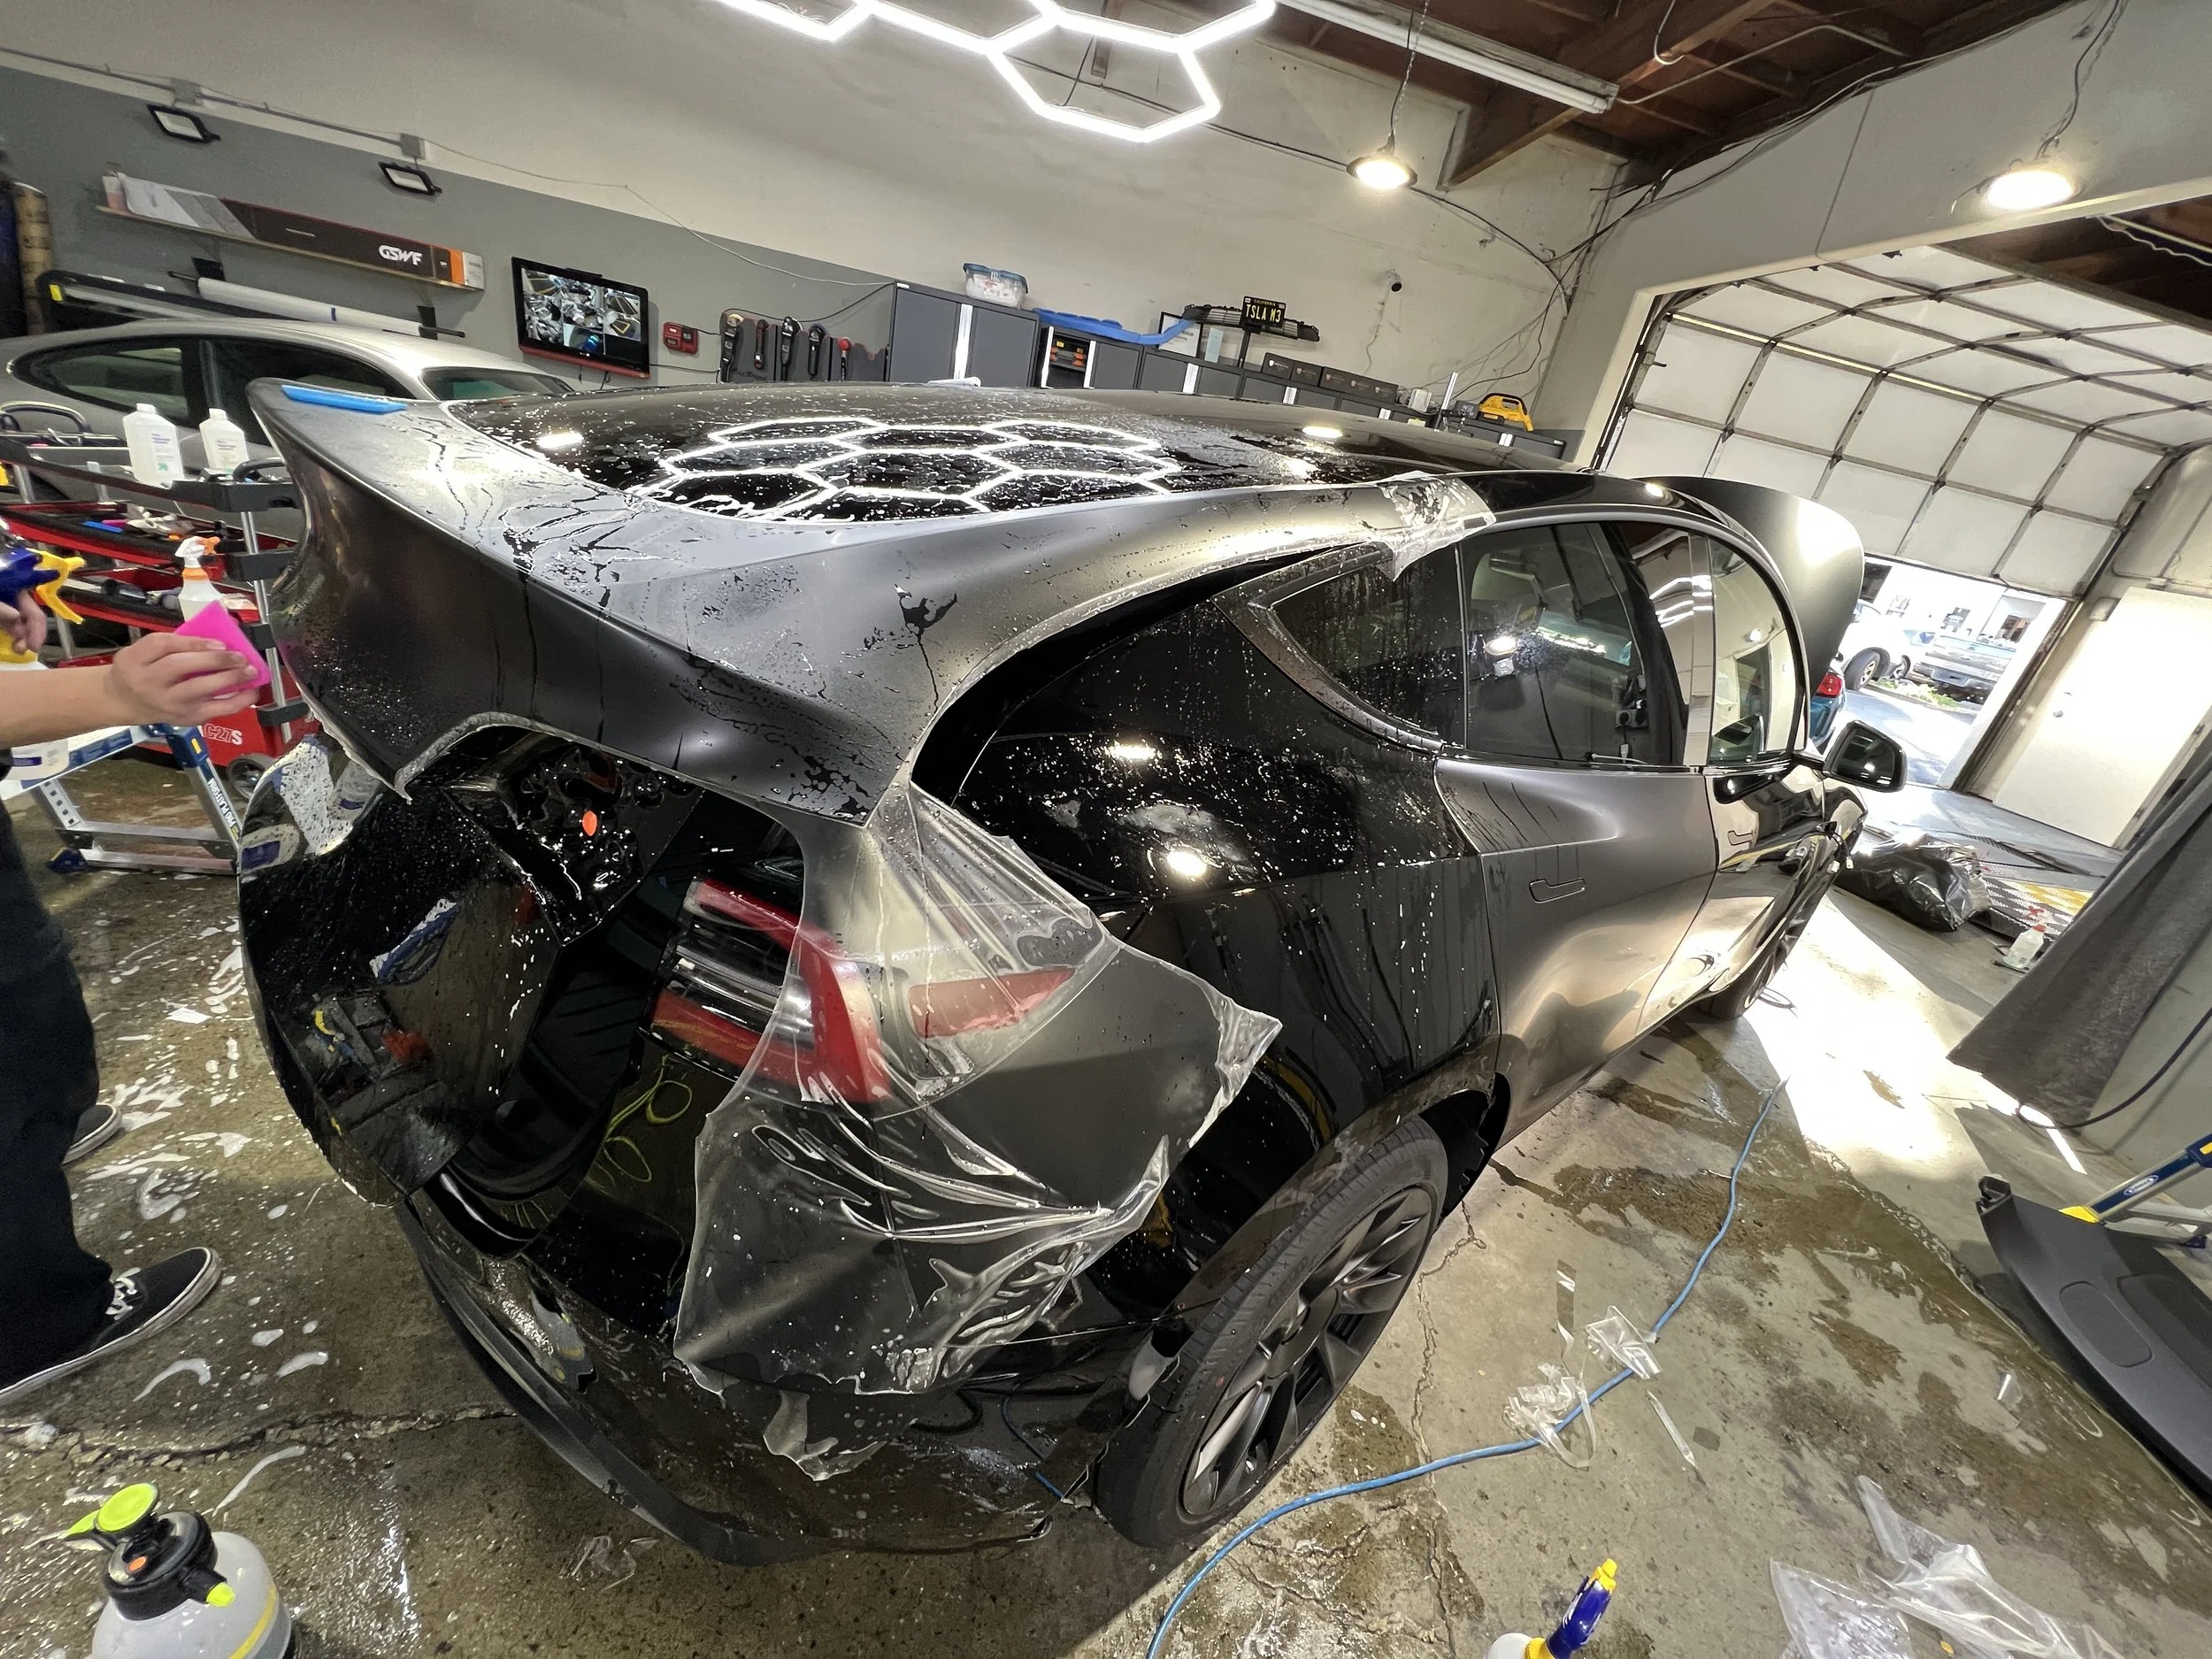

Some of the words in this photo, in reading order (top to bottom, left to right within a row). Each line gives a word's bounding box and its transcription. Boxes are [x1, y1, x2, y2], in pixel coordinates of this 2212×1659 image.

[379, 244, 423, 266] GSWF
[1246, 303, 1267, 320] TSLA
[1270, 308, 1282, 323] M3
[208, 778, 230, 814] PLATFORM
[225, 810, 236, 827] PRO
